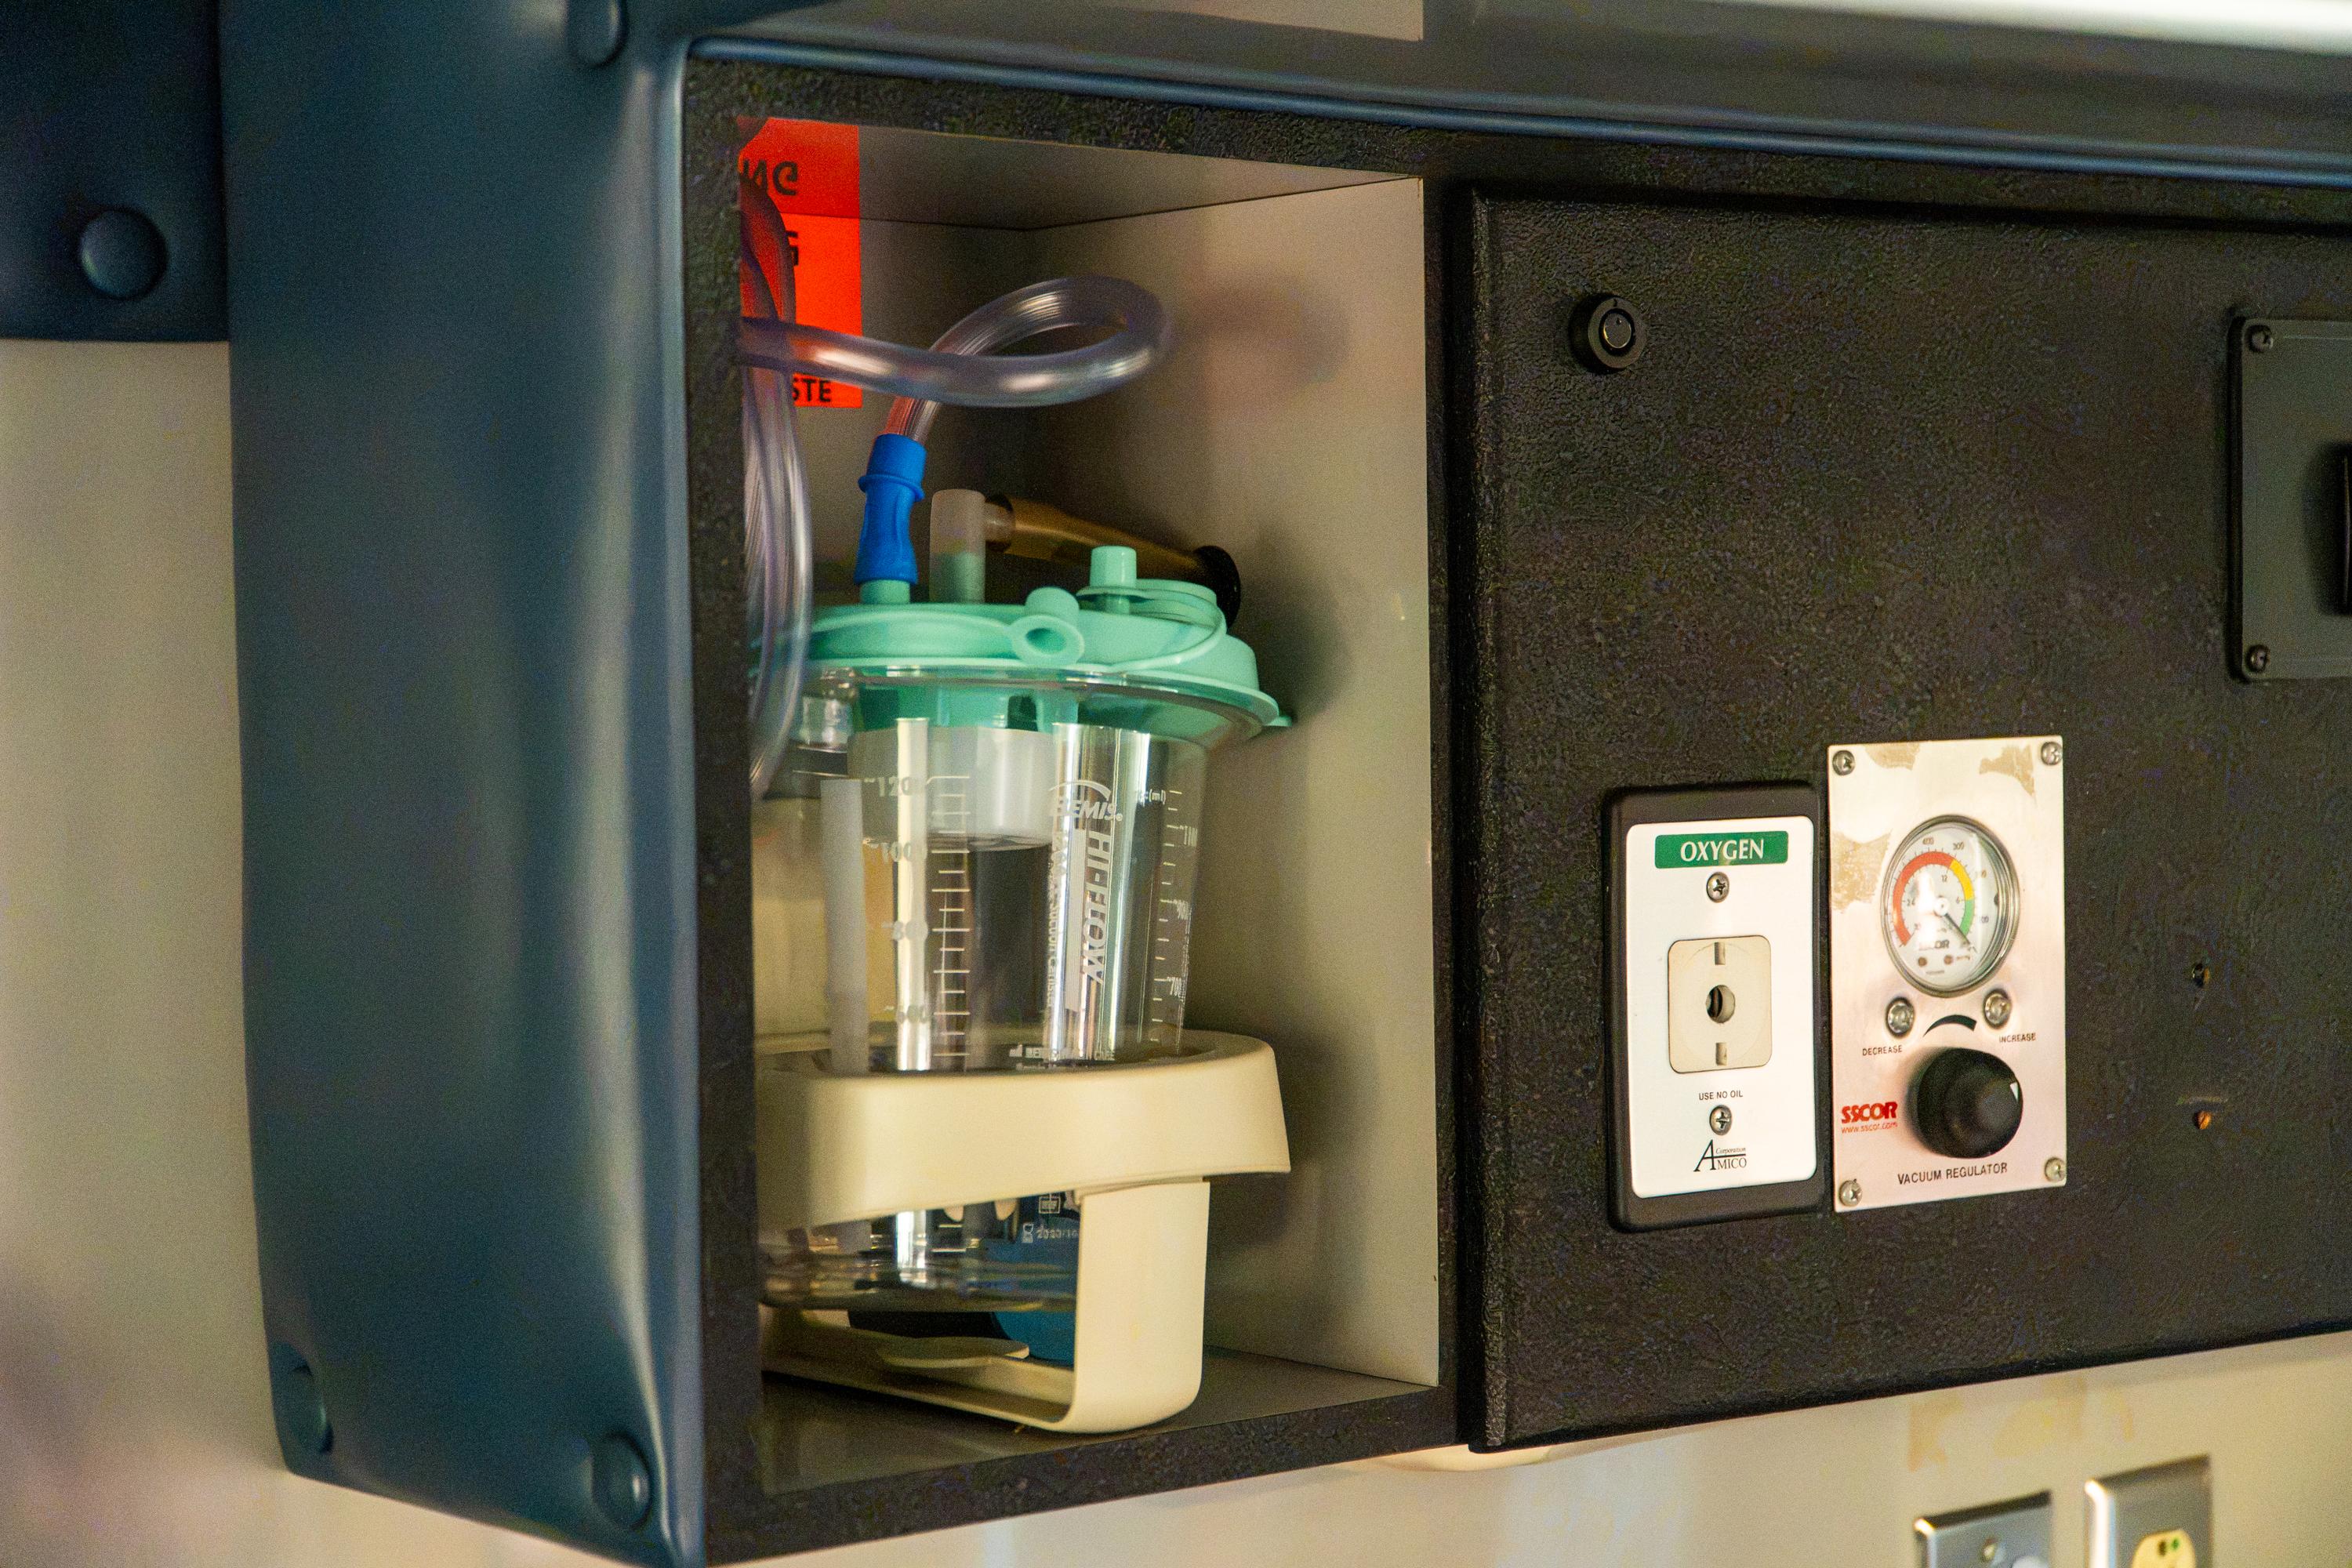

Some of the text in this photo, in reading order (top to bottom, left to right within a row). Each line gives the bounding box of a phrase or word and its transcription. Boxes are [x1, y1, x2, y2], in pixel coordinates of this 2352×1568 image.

[1680, 838, 1765, 862] OXYGEN
[1941, 874, 1948, 883] 12
[1081, 829, 1112, 985] HI-FLOW
[1999, 1033, 2036, 1044] INCREASE
[1862, 1045, 1903, 1056] DECREASE
[1699, 1092, 1714, 1101] USE
[1730, 1090, 1744, 1098] OIL
[1842, 1101, 1898, 1124] SSCOR
[1693, 1139, 1748, 1172] AMICO
[1897, 1162, 2008, 1185] VACUUM REGULATOR
